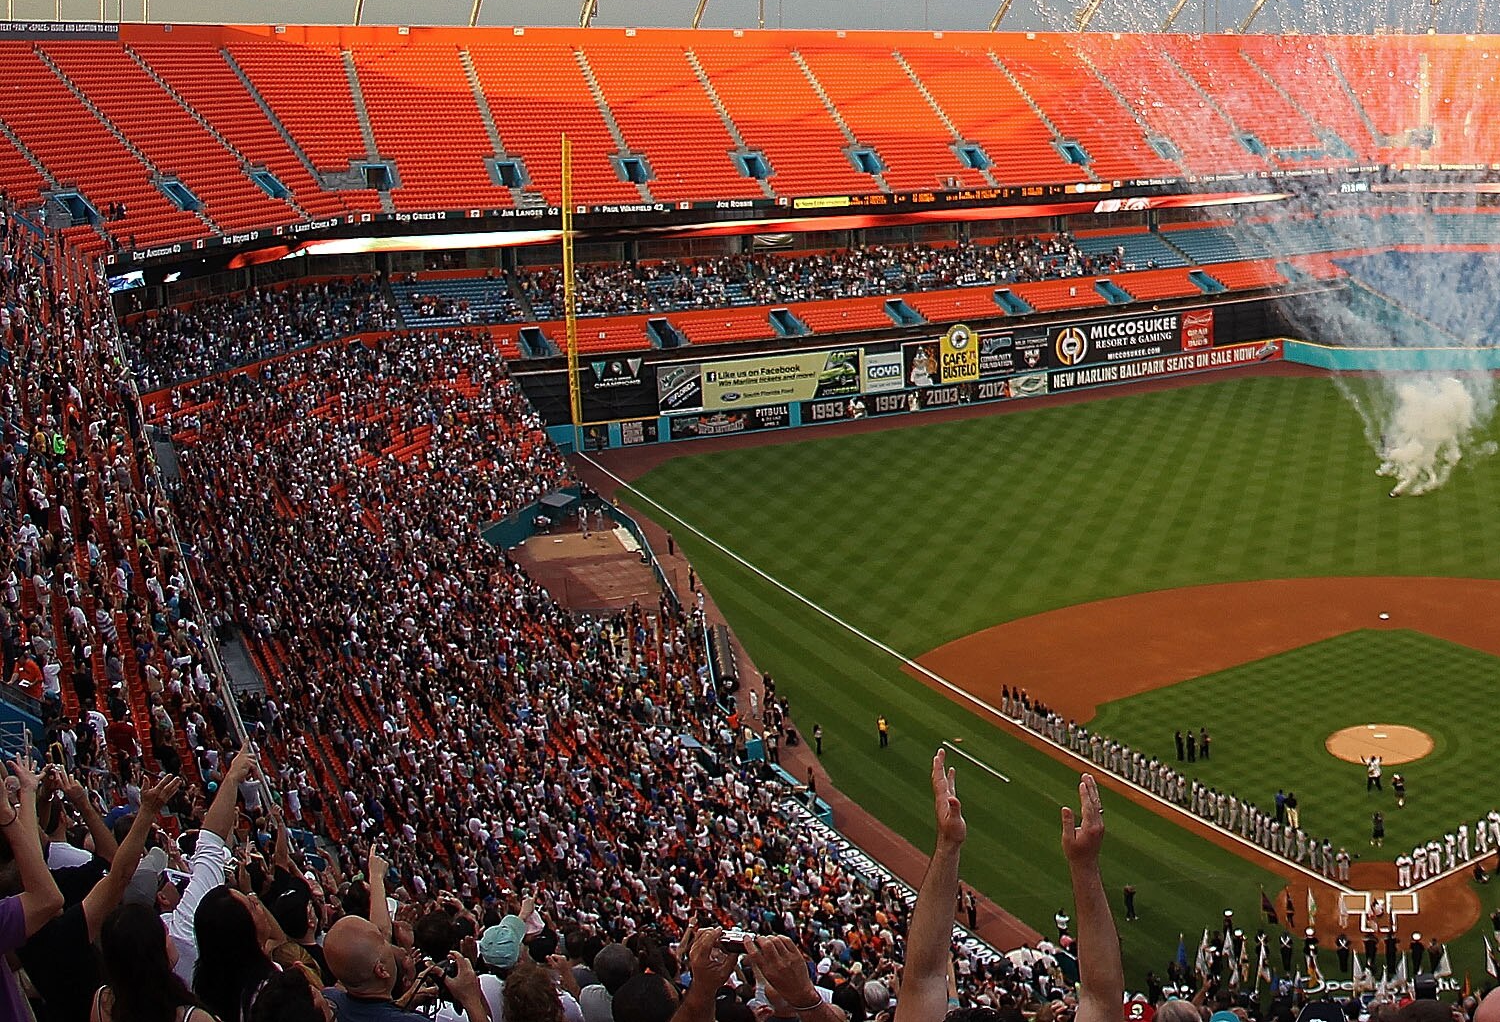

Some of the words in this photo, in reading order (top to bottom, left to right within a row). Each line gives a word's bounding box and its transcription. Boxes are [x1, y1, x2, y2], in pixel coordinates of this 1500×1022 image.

[436, 211, 446, 220] 12
[1090, 316, 1177, 340] MICCOSUKEE
[1095, 338, 1127, 349] RESORT
[1129, 337, 1137, 345] &
[1138, 332, 1172, 344] GAMING
[1107, 347, 1161, 361] MICCOSUKEE.COM
[718, 371, 735, 380] Like
[760, 364, 800, 376] Facebook
[868, 364, 901, 378] GOYA
[942, 363, 977, 379] BUSTELO
[1053, 372, 1076, 389] NEW
[1077, 366, 1118, 385] MARLINS
[1119, 360, 1165, 379] BALLPARK
[1166, 355, 1195, 373] SEATS
[1196, 352, 1209, 367] ON
[1210, 349, 1232, 365] SALE
[1233, 346, 1256, 362] NOW!
[594, 379, 641, 389] CHAMPIONS
[978, 381, 1006, 399] 2012
[875, 394, 906, 413] 1997
[926, 388, 958, 406] 2003
[755, 404, 789, 418] PITBULL
[811, 400, 844, 420] 1993
[623, 436, 644, 445] DOWN
